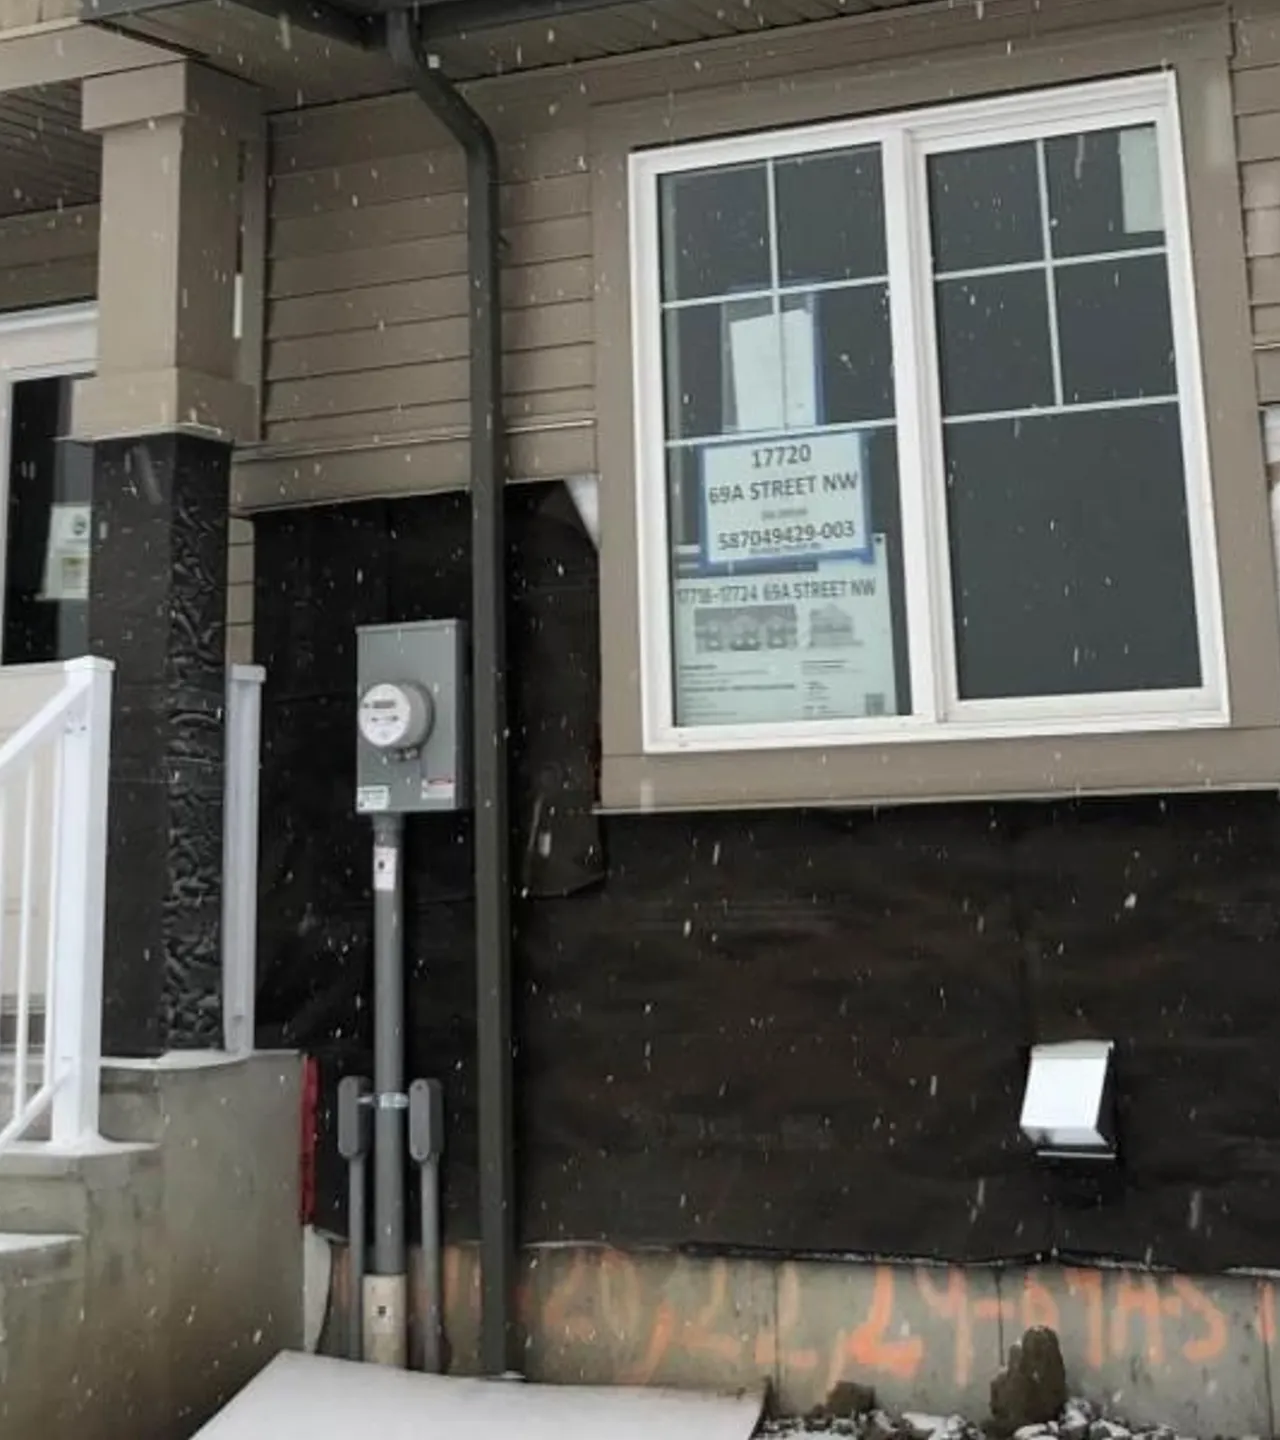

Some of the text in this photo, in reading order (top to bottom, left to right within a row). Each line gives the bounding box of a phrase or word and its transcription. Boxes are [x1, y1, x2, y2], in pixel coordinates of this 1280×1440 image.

[752, 444, 812, 468] 17720
[708, 471, 858, 505] 69A STREET NW
[793, 578, 847, 600] STREET
[850, 575, 877, 597] NW
